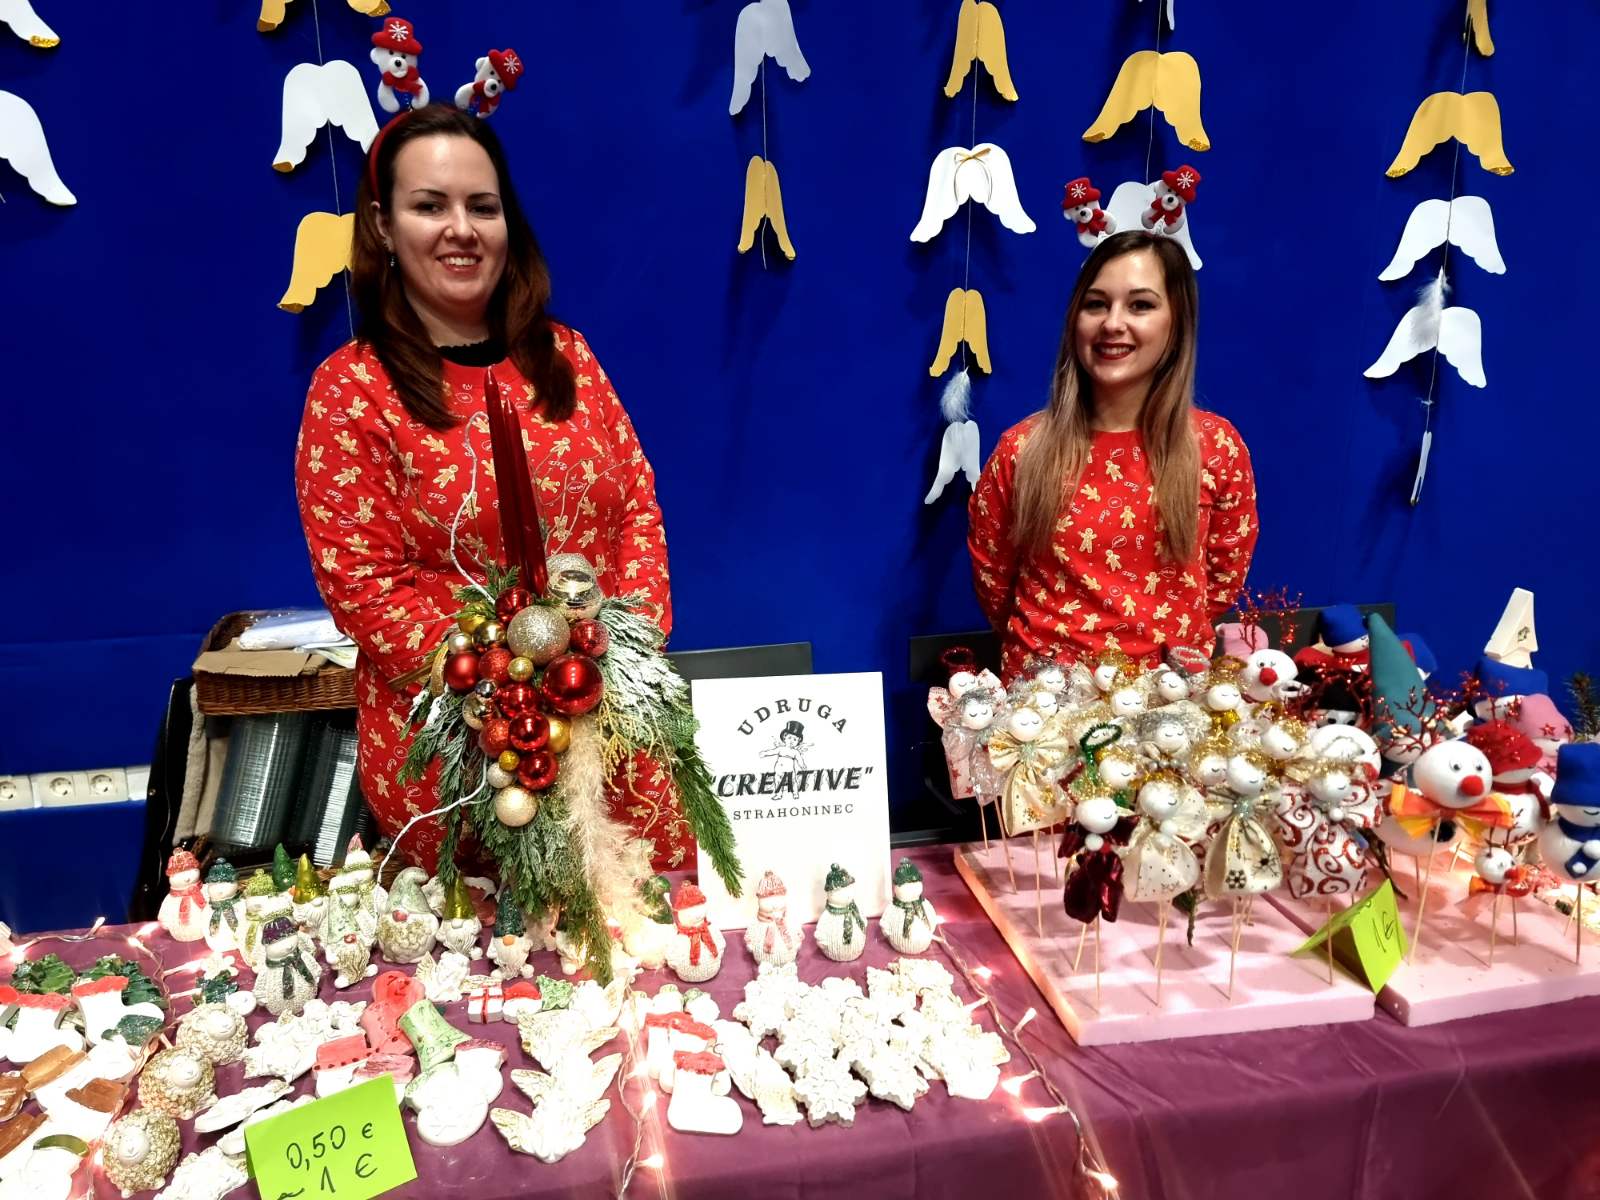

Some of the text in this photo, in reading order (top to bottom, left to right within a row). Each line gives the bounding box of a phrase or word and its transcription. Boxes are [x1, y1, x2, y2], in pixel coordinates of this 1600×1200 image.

[737, 698, 847, 736] UDRUGA
[733, 803, 855, 821] STRAHONINEC
[286, 1122, 374, 1171] 0,50 €
[320, 1165, 336, 1193] 1
[355, 1153, 378, 1178] €
